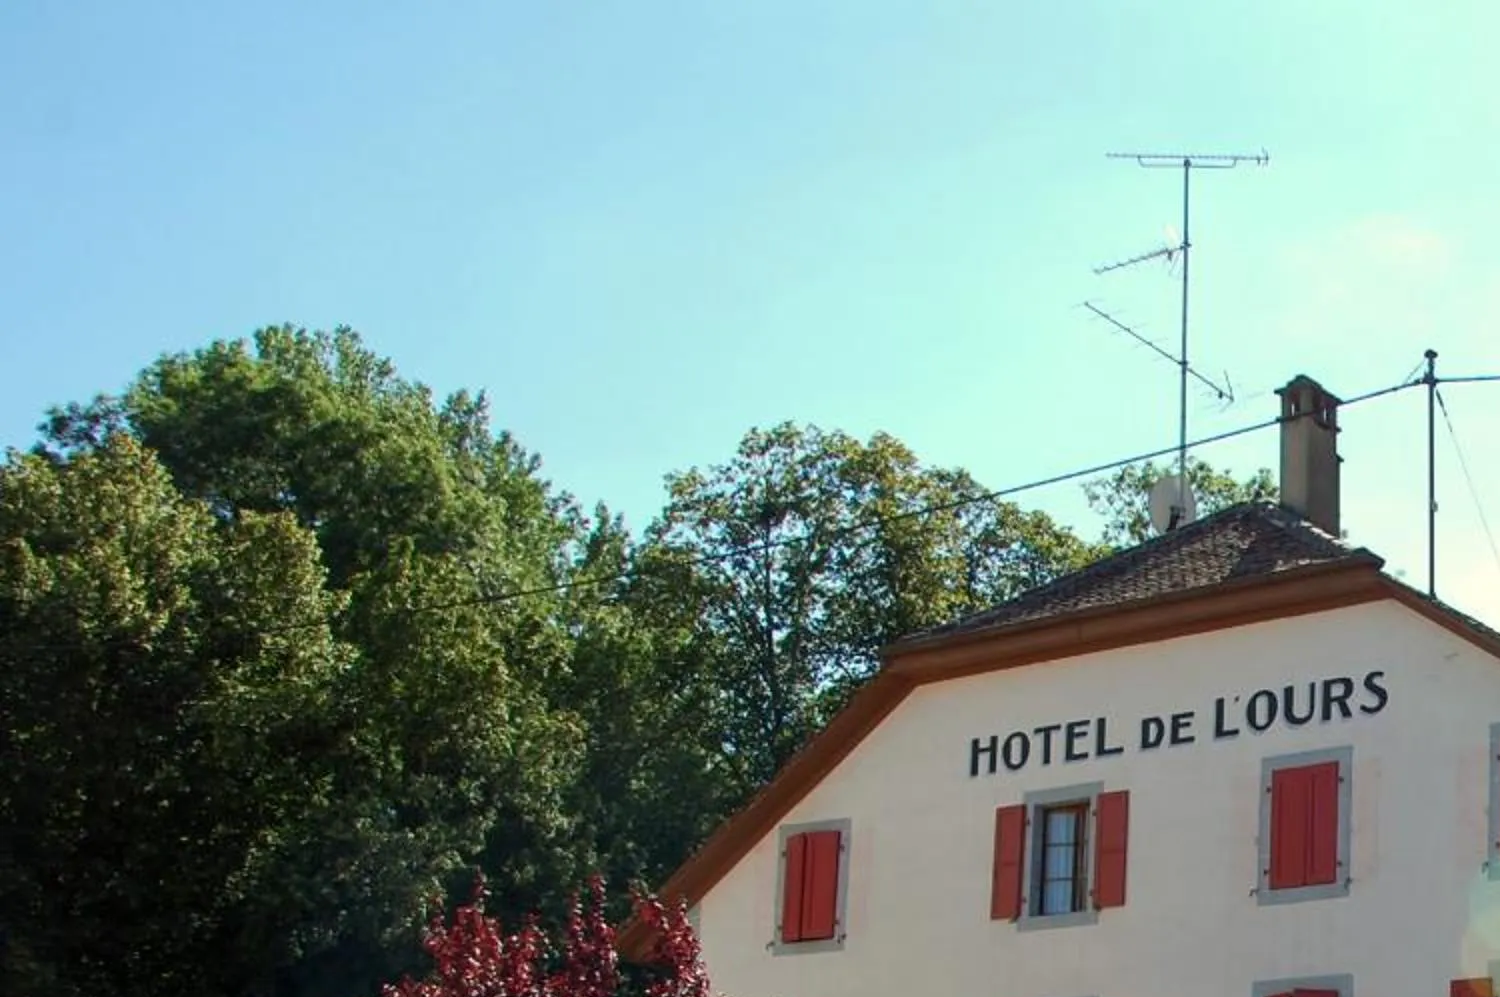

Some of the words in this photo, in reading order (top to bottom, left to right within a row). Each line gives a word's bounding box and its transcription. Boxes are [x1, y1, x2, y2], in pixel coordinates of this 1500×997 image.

[968, 717, 1124, 777] HOTEL
[1140, 711, 1197, 750] DE
[1213, 671, 1389, 740] L'OURS
